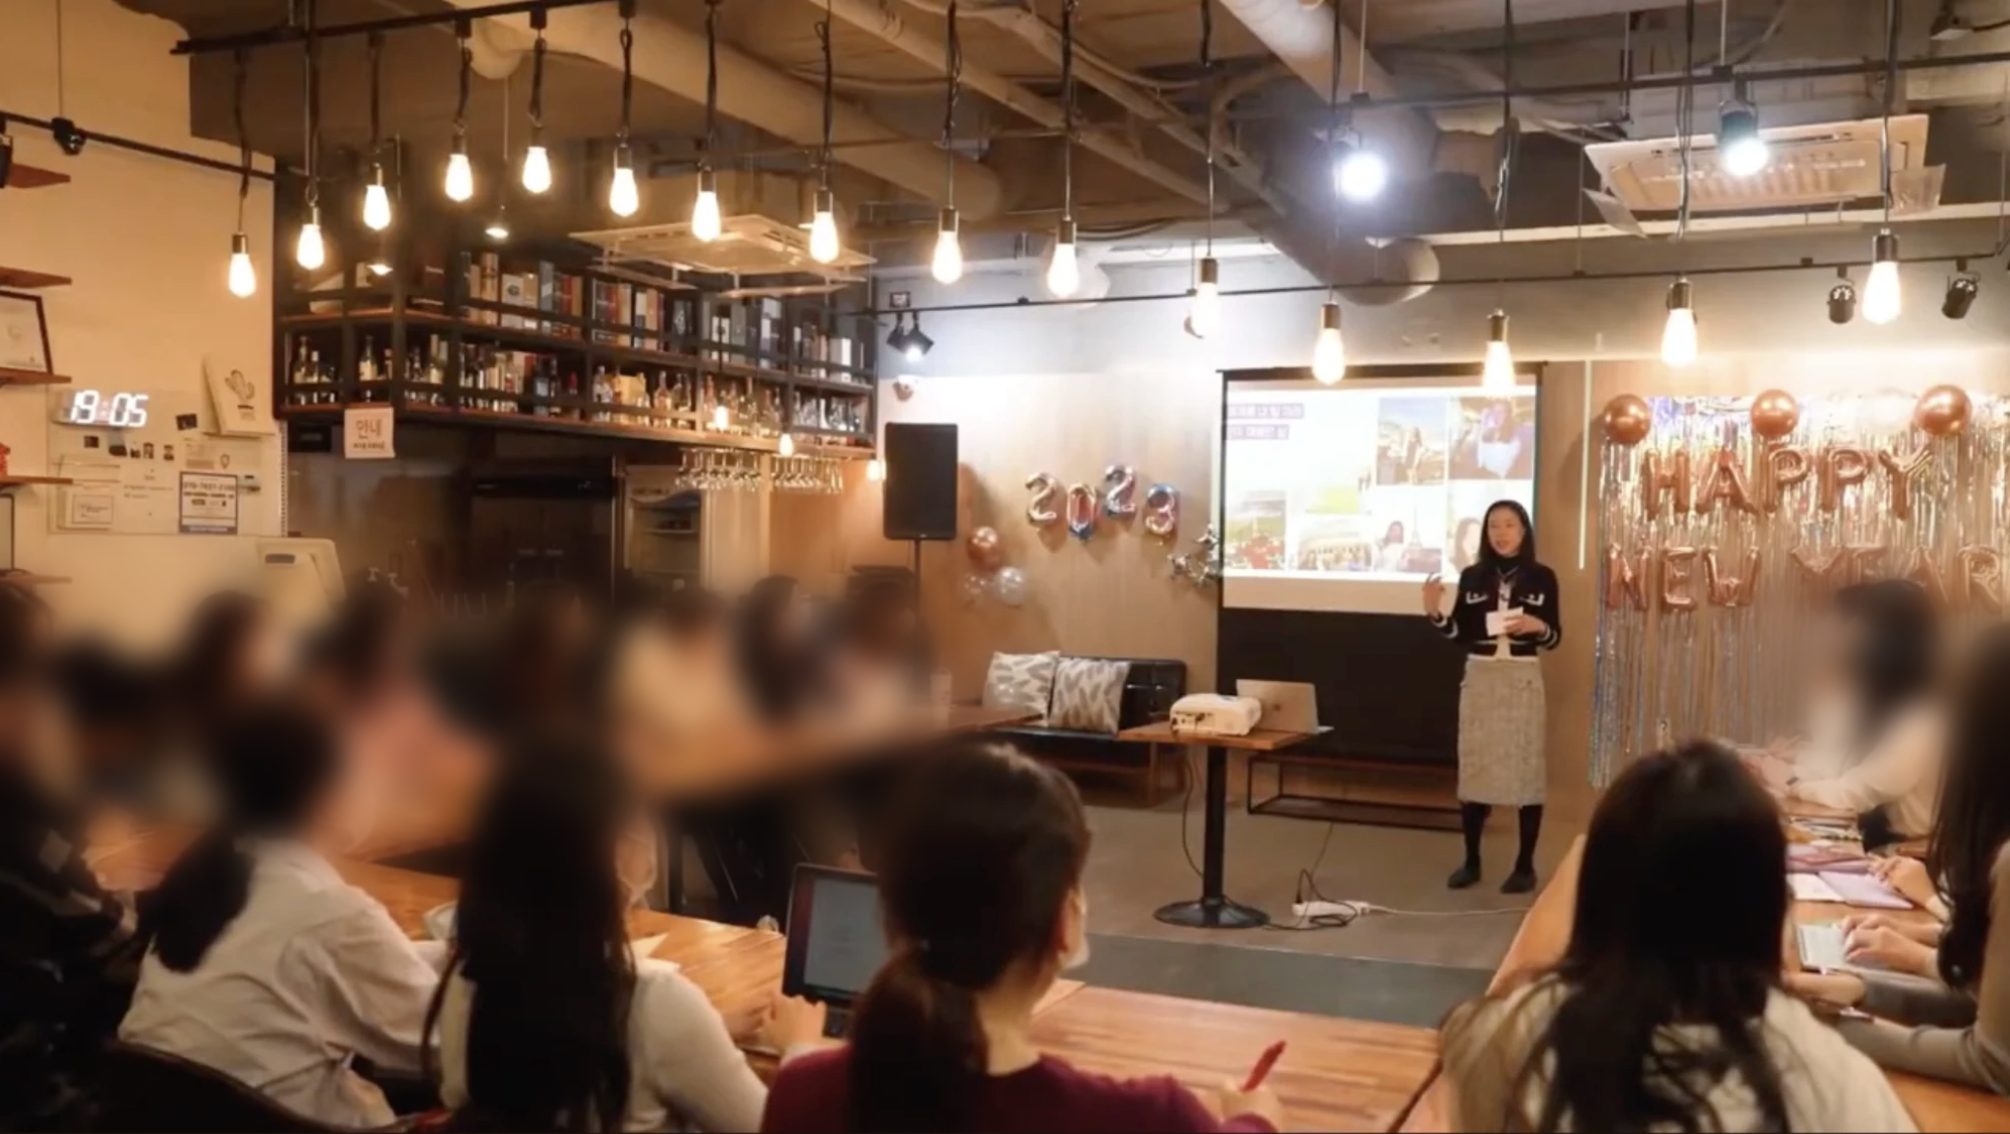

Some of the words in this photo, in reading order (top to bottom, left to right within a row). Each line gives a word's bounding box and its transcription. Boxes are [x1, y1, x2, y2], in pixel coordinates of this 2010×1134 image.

[70, 389, 149, 428] 19:05
[1025, 463, 1175, 540] 2023
[1643, 443, 1932, 521] HAPPY
[1605, 542, 1759, 610] NEW
